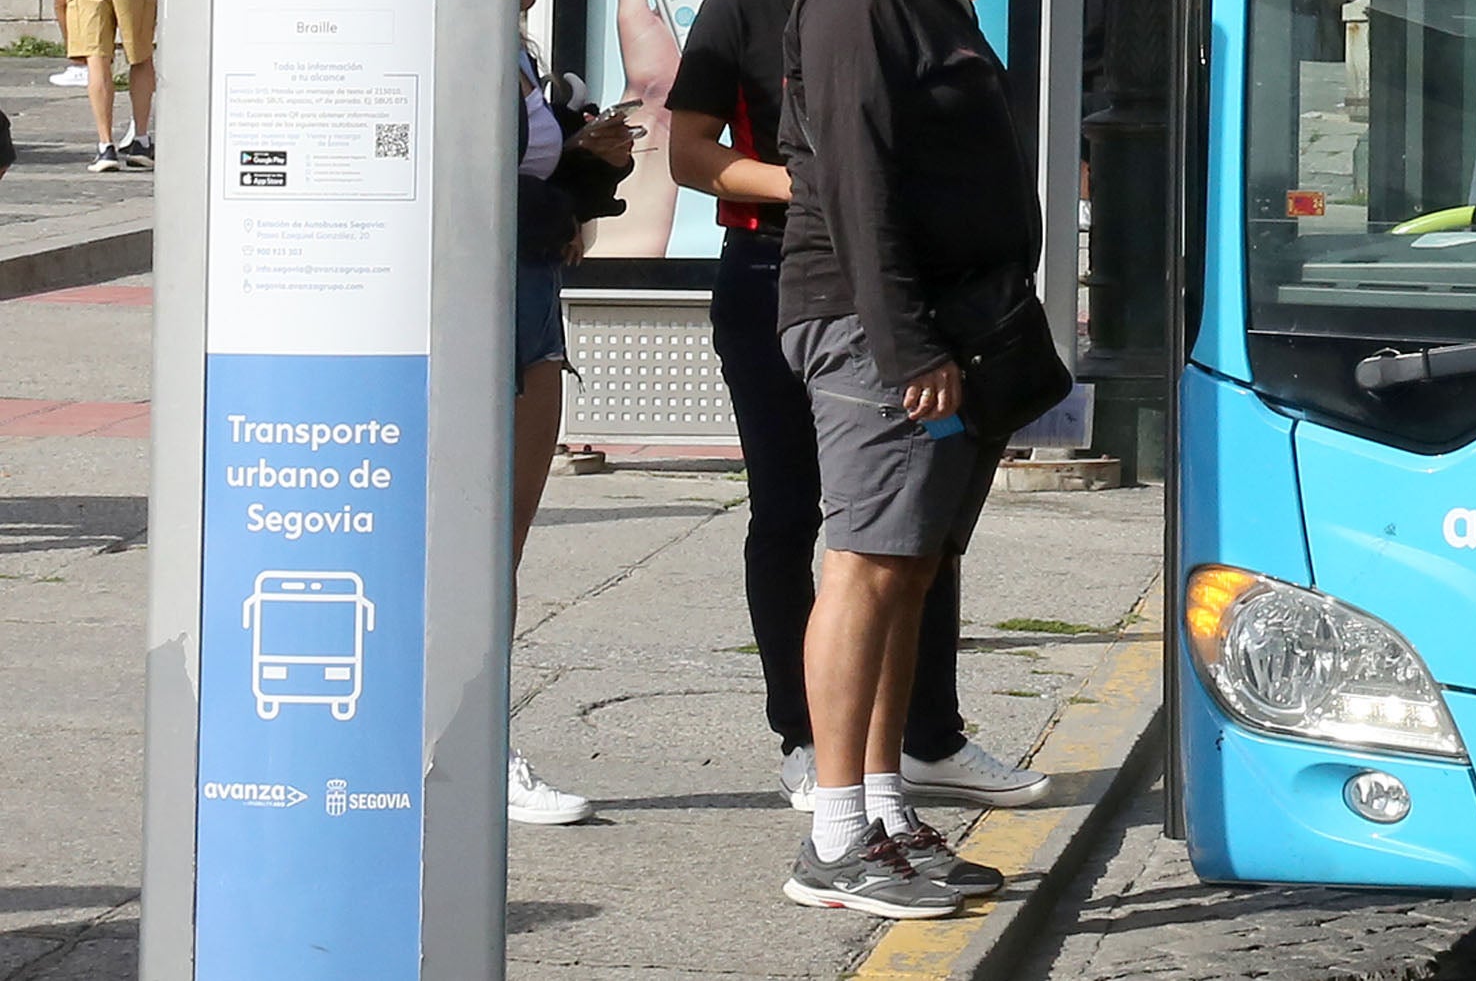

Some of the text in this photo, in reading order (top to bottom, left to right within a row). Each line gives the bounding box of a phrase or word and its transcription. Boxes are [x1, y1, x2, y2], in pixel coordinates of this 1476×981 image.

[296, 21, 338, 34] Braille
[227, 413, 401, 452] Transporte
[226, 458, 392, 490] urbano de
[246, 502, 375, 541] Segovia
[203, 781, 412, 810] avanza SEGOVIA
